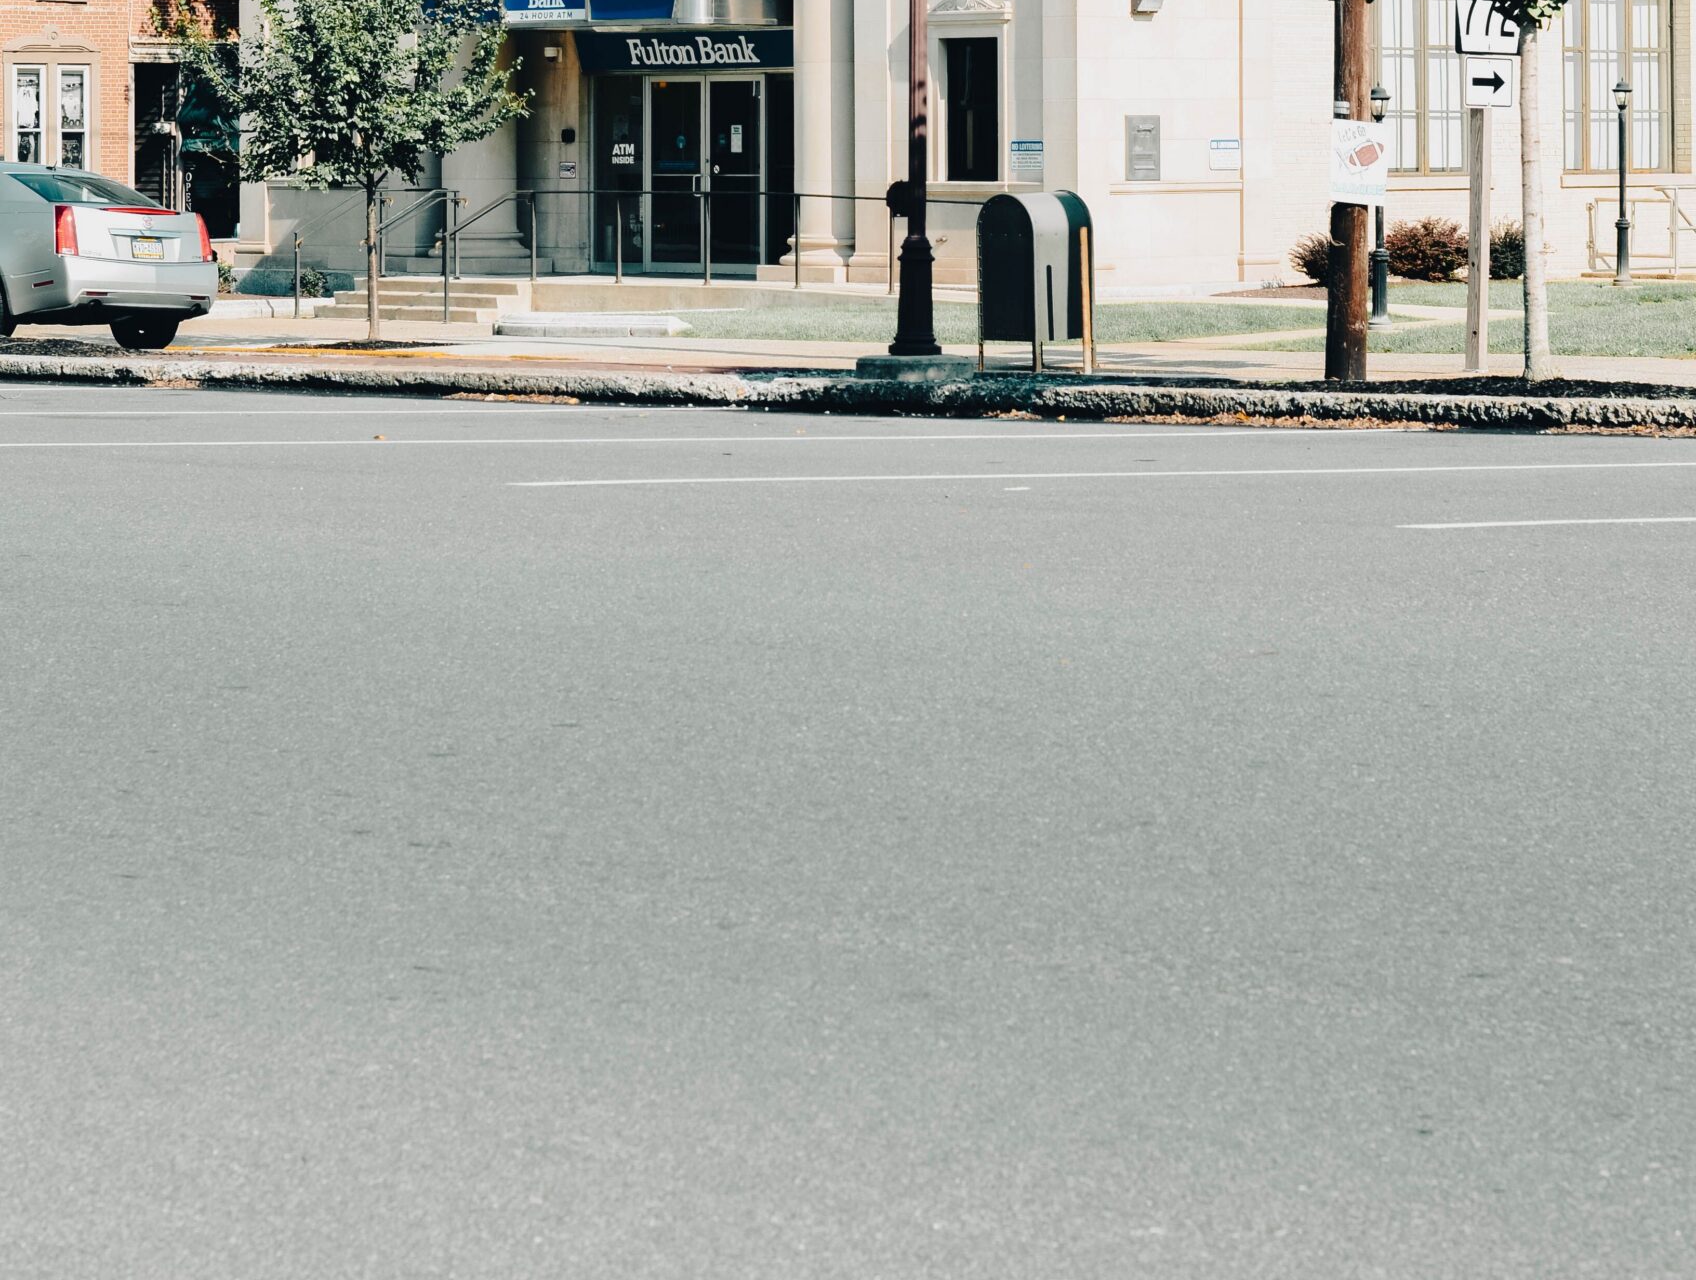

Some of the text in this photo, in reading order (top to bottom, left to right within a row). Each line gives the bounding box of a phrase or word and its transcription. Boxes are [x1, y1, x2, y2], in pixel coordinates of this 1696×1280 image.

[520, 11, 573, 20] 24 HOUR ATM
[626, 35, 761, 65] Fulton Bank
[612, 143, 635, 156] ATM
[611, 156, 635, 165] INSIDE
[185, 172, 193, 212] OPEN
